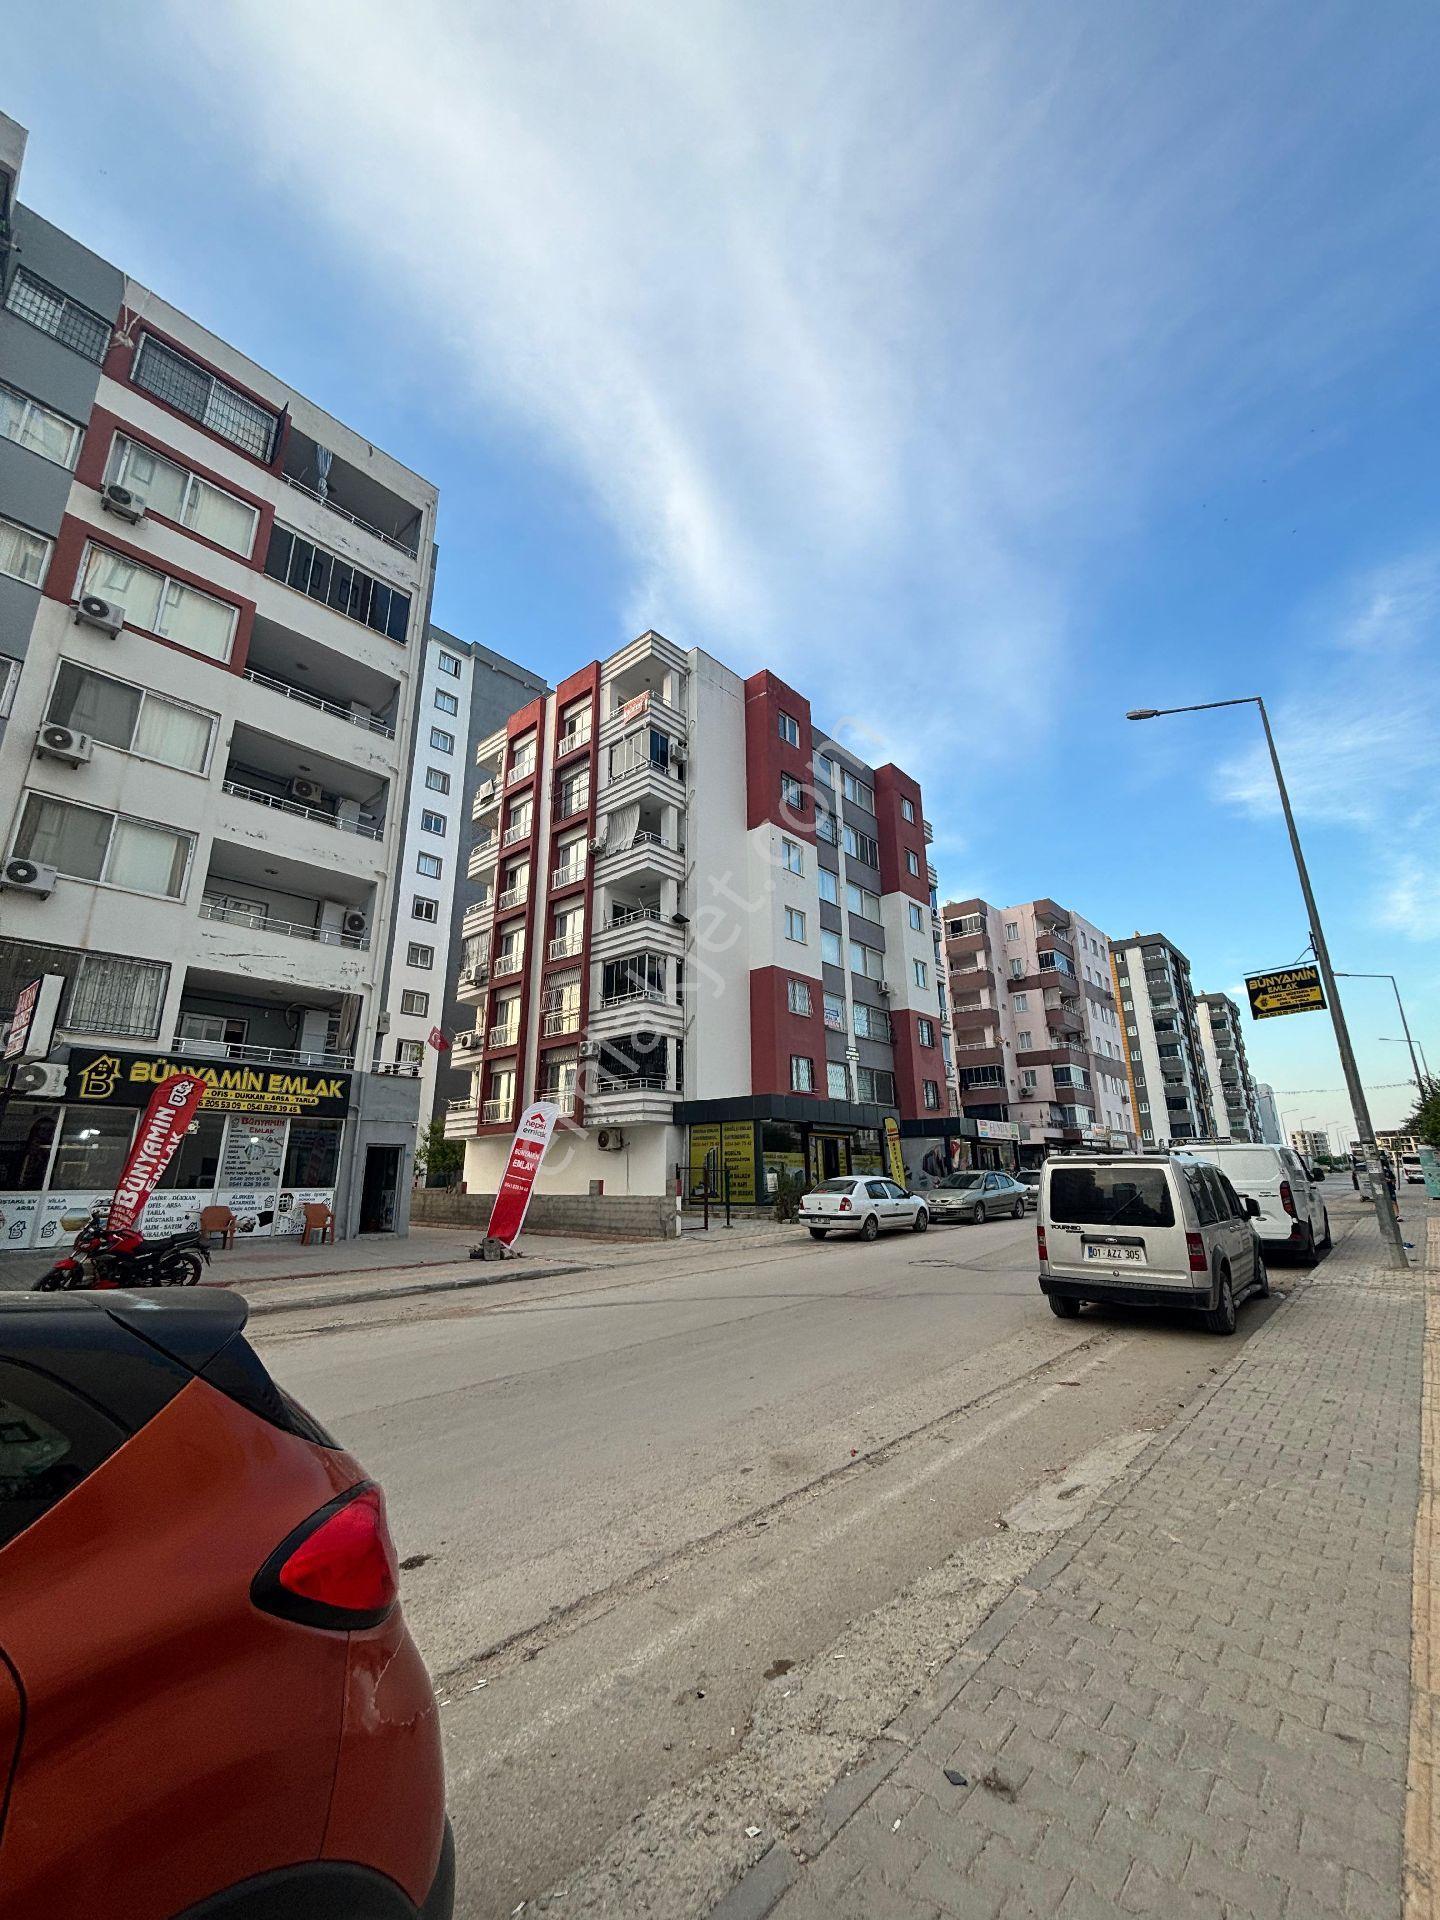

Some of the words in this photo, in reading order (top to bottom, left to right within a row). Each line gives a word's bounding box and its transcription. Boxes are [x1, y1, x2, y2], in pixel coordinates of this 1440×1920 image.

[1249, 967, 1316, 990] BÜNYAMİN
[1267, 982, 1298, 993] EMLAK
[129, 1057, 265, 1091] BÜNYAMİN
[268, 1073, 346, 1098] EMLAK
[525, 1119, 546, 1130] hepsi
[522, 1127, 547, 1138] emlak
[115, 1106, 177, 1210] BÜNYAMİN
[146, 1132, 184, 1193] EMLAK
[512, 1159, 534, 1171] EMLAK
[1092, 1248, 1101, 1257] 01
[1107, 1249, 1122, 1258] AZZ
[1125, 1249, 1140, 1260] 305
